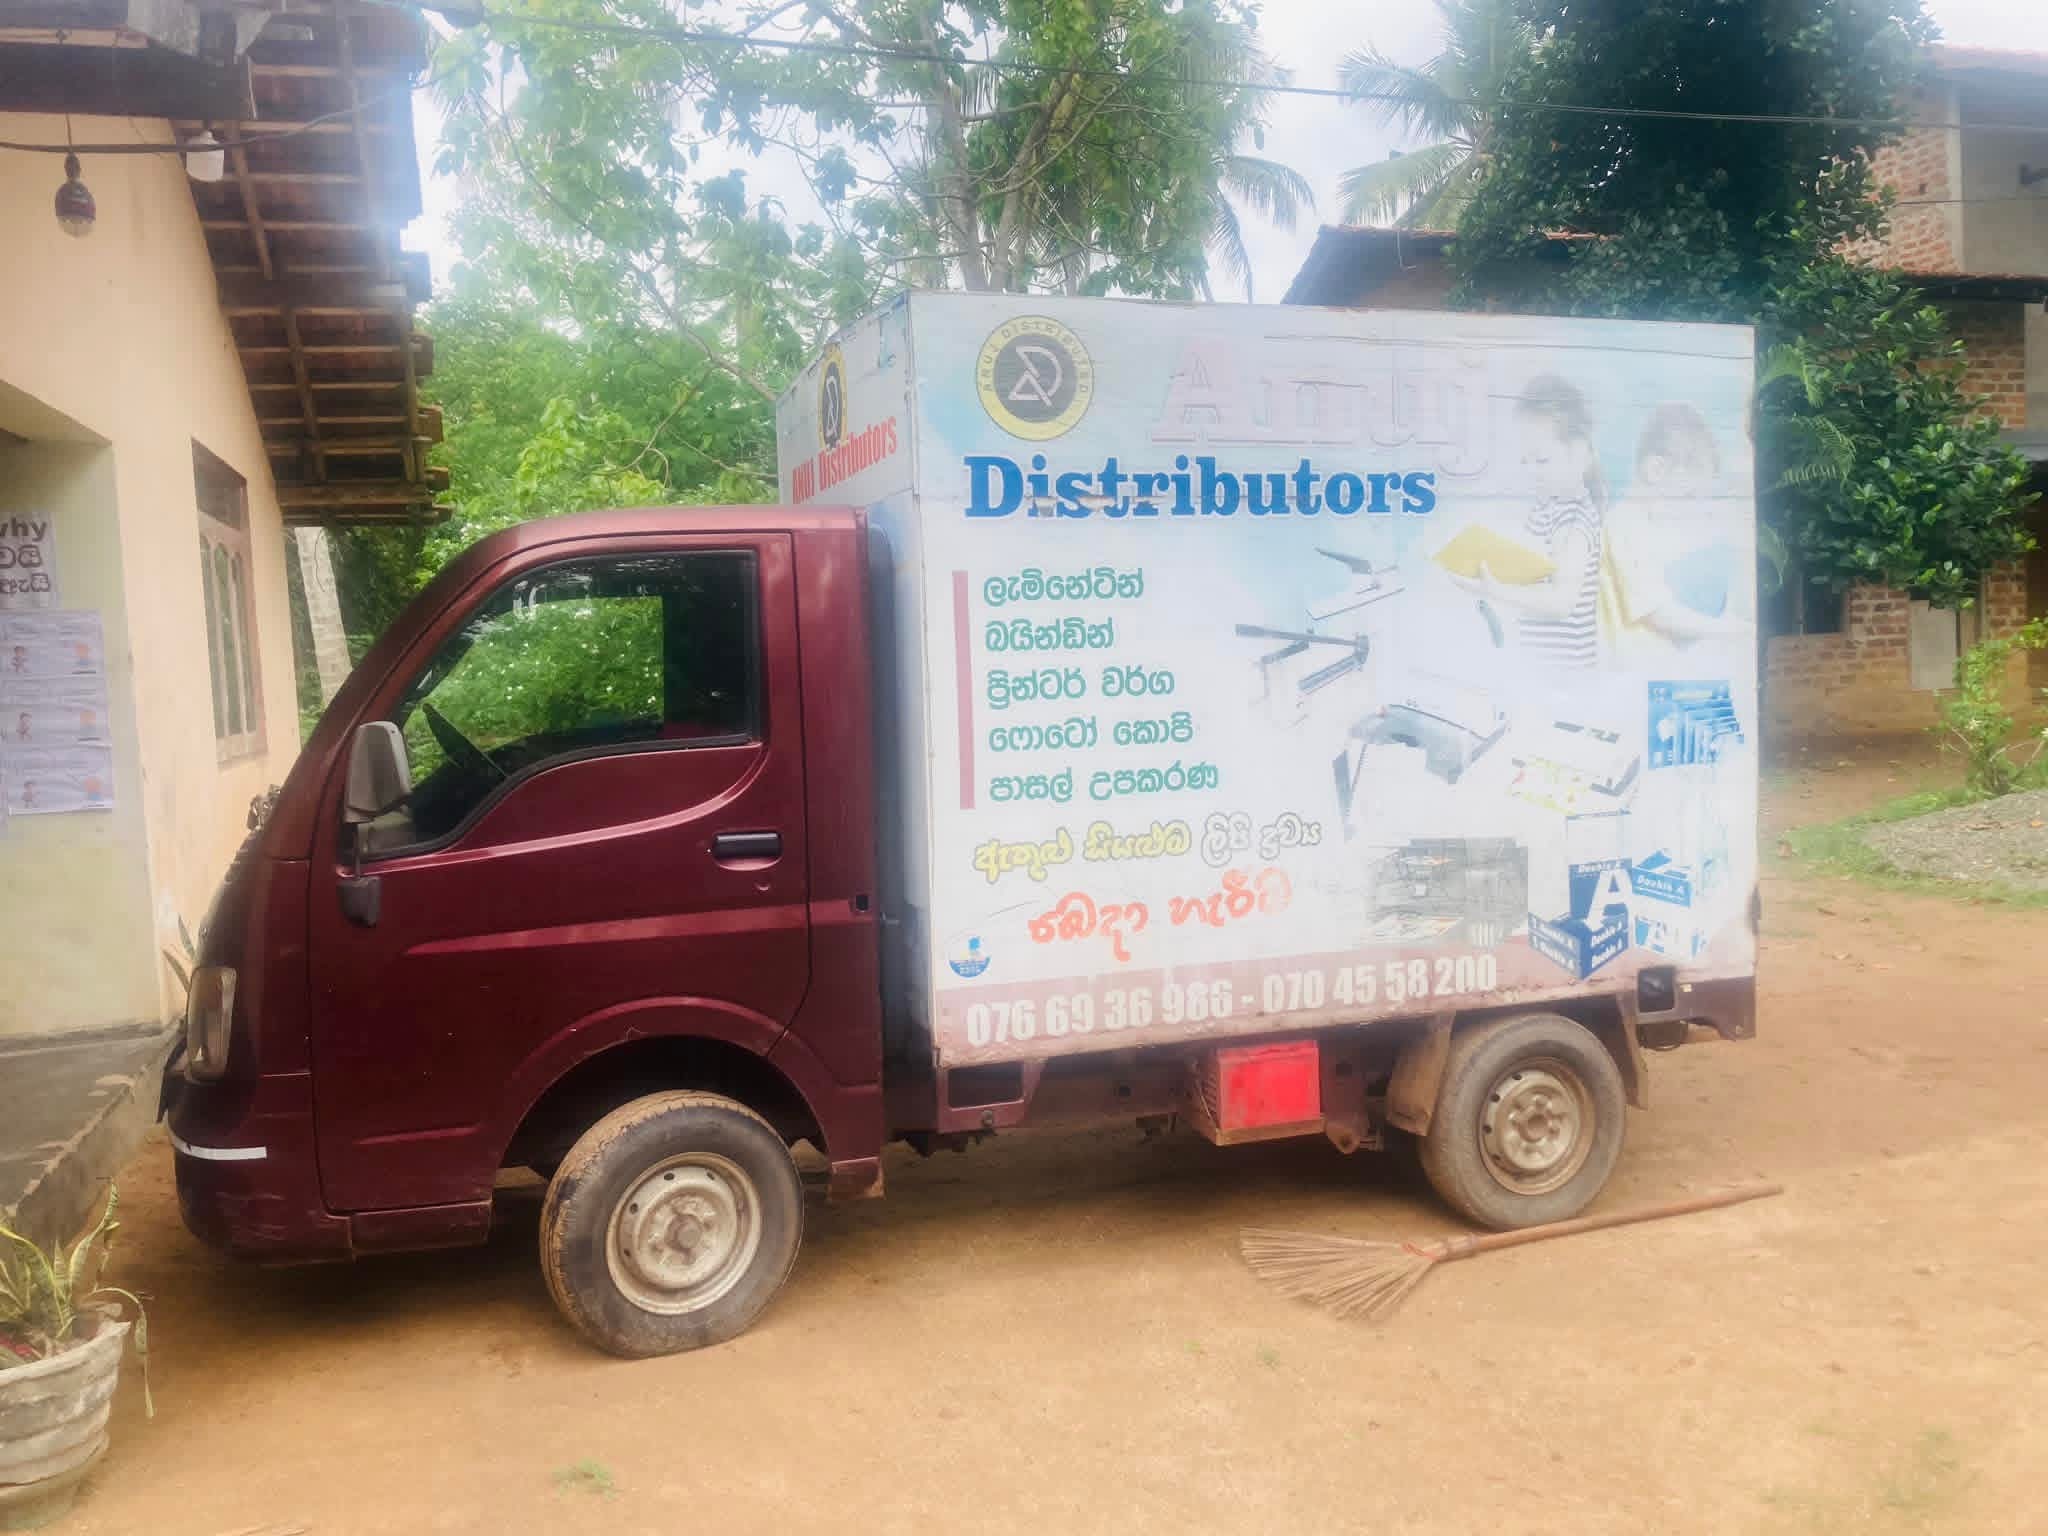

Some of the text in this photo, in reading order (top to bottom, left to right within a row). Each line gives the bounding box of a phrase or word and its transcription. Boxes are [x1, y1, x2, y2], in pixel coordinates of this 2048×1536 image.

[818, 415, 897, 492] Distributors
[963, 453, 1436, 518] Distributors
[984, 616, 1114, 653] බයින්ඩින්
[1101, 664, 1176, 698] වර්ග
[989, 710, 1194, 752] ෆොටෝ කොපි
[989, 760, 1219, 803] පාසල් උපකරණ
[966, 1001, 1036, 1049] 076
[1045, 994, 1094, 1037] 69
[1104, 988, 1153, 1031] 36
[1162, 978, 1233, 1025] 986
[1263, 968, 1324, 1014] 070
[1333, 963, 1377, 1006] 45
[1385, 957, 1428, 1001] 58
[1435, 954, 1497, 998] 200
